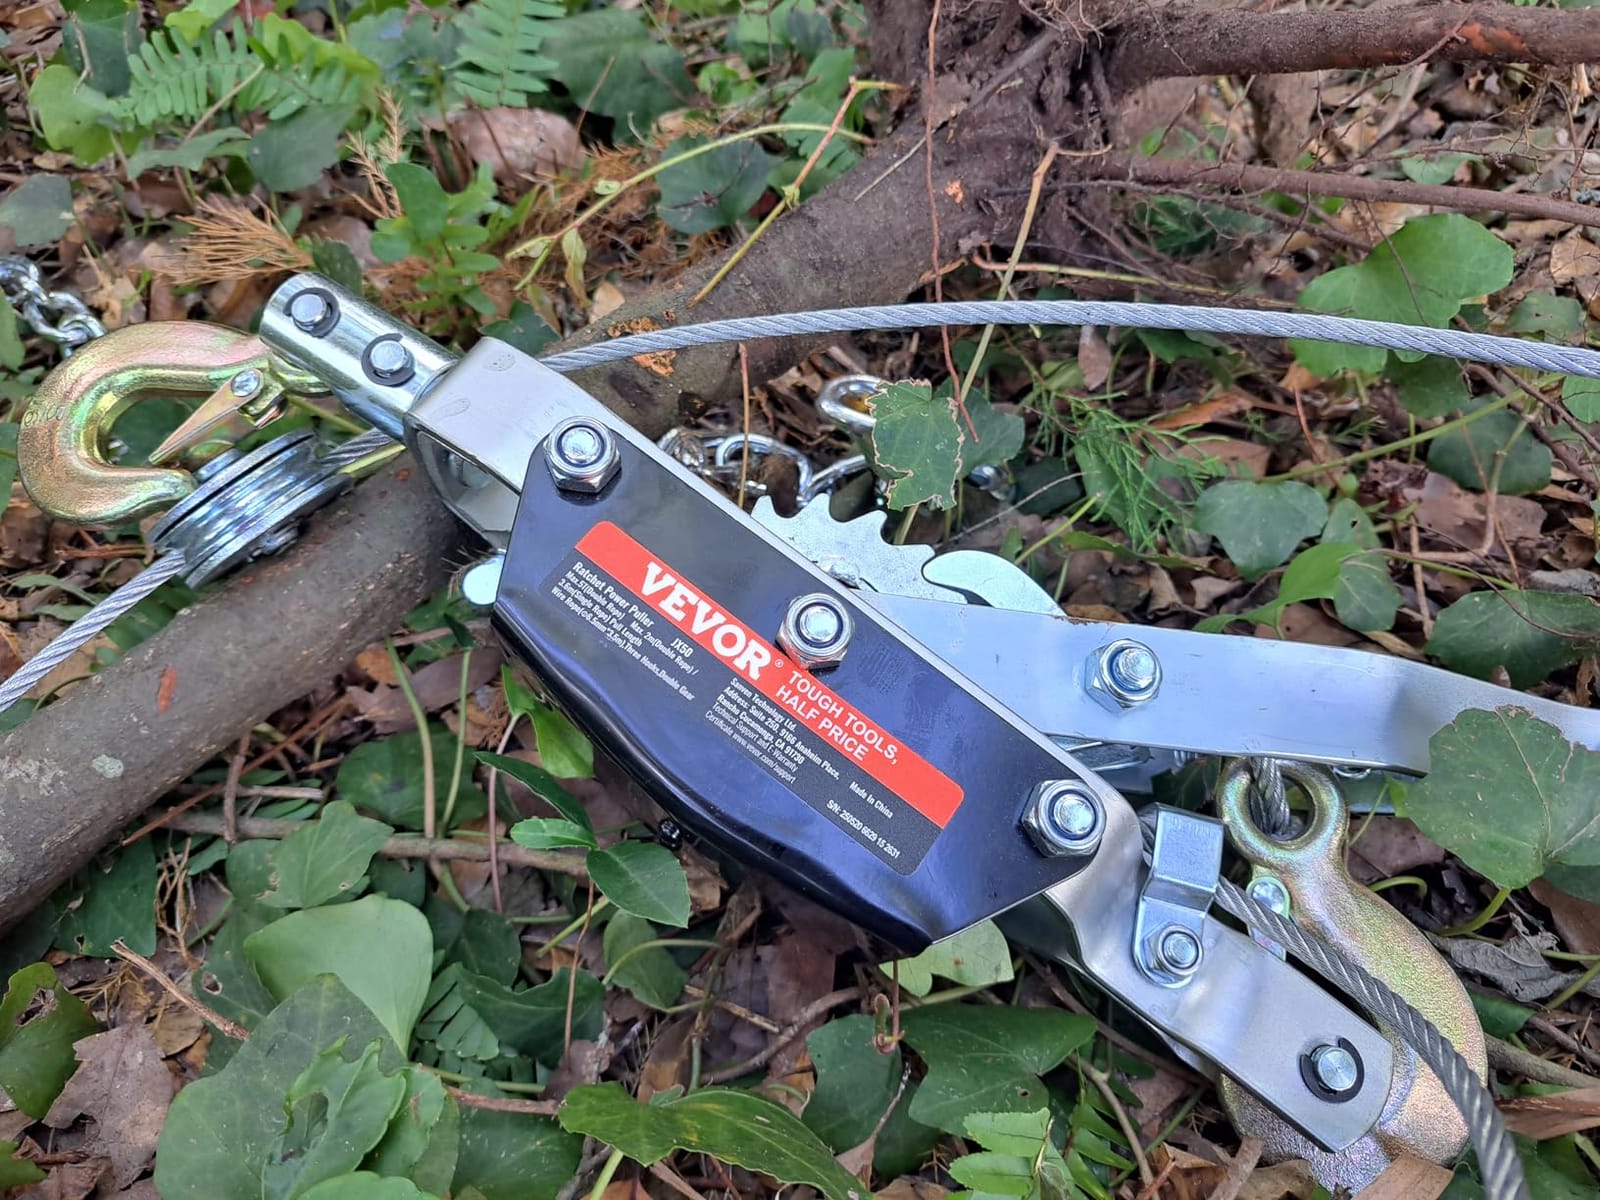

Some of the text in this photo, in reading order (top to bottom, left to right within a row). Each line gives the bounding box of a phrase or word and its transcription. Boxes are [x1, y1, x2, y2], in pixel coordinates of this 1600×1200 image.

[558, 578, 642, 647] 3.6m(Single Rope) Pull Length
[573, 562, 654, 627] Ratchet Power Puller
[642, 562, 771, 680] VEVOR
[552, 586, 566, 600] Wire
[679, 686, 695, 700] Gear
[606, 602, 625, 620] Rope)
[630, 621, 644, 635] Max.
[644, 632, 676, 659] 2m(Double
[674, 655, 694, 673] Rope)
[670, 638, 693, 657] JX50
[712, 701, 798, 772] Technical Support and E-Warranty
[717, 694, 805, 764] Rancho Cucamonga, CA 91730
[723, 686, 750, 709] Address:
[749, 705, 766, 721] Suite
[779, 728, 797, 744] 9166
[795, 741, 822, 765] Anaheim
[821, 760, 839, 780] Place,
[730, 677, 797, 732] Sanven Technology Ltd.
[776, 685, 868, 760] HALF PRICE
[789, 671, 897, 766] TOUGH TOOLS,
[705, 710, 796, 784] Certificate www.vevor.com/support
[827, 800, 900, 858] S/N: 250520 6629 15 2631
[849, 781, 893, 818] Made In China
